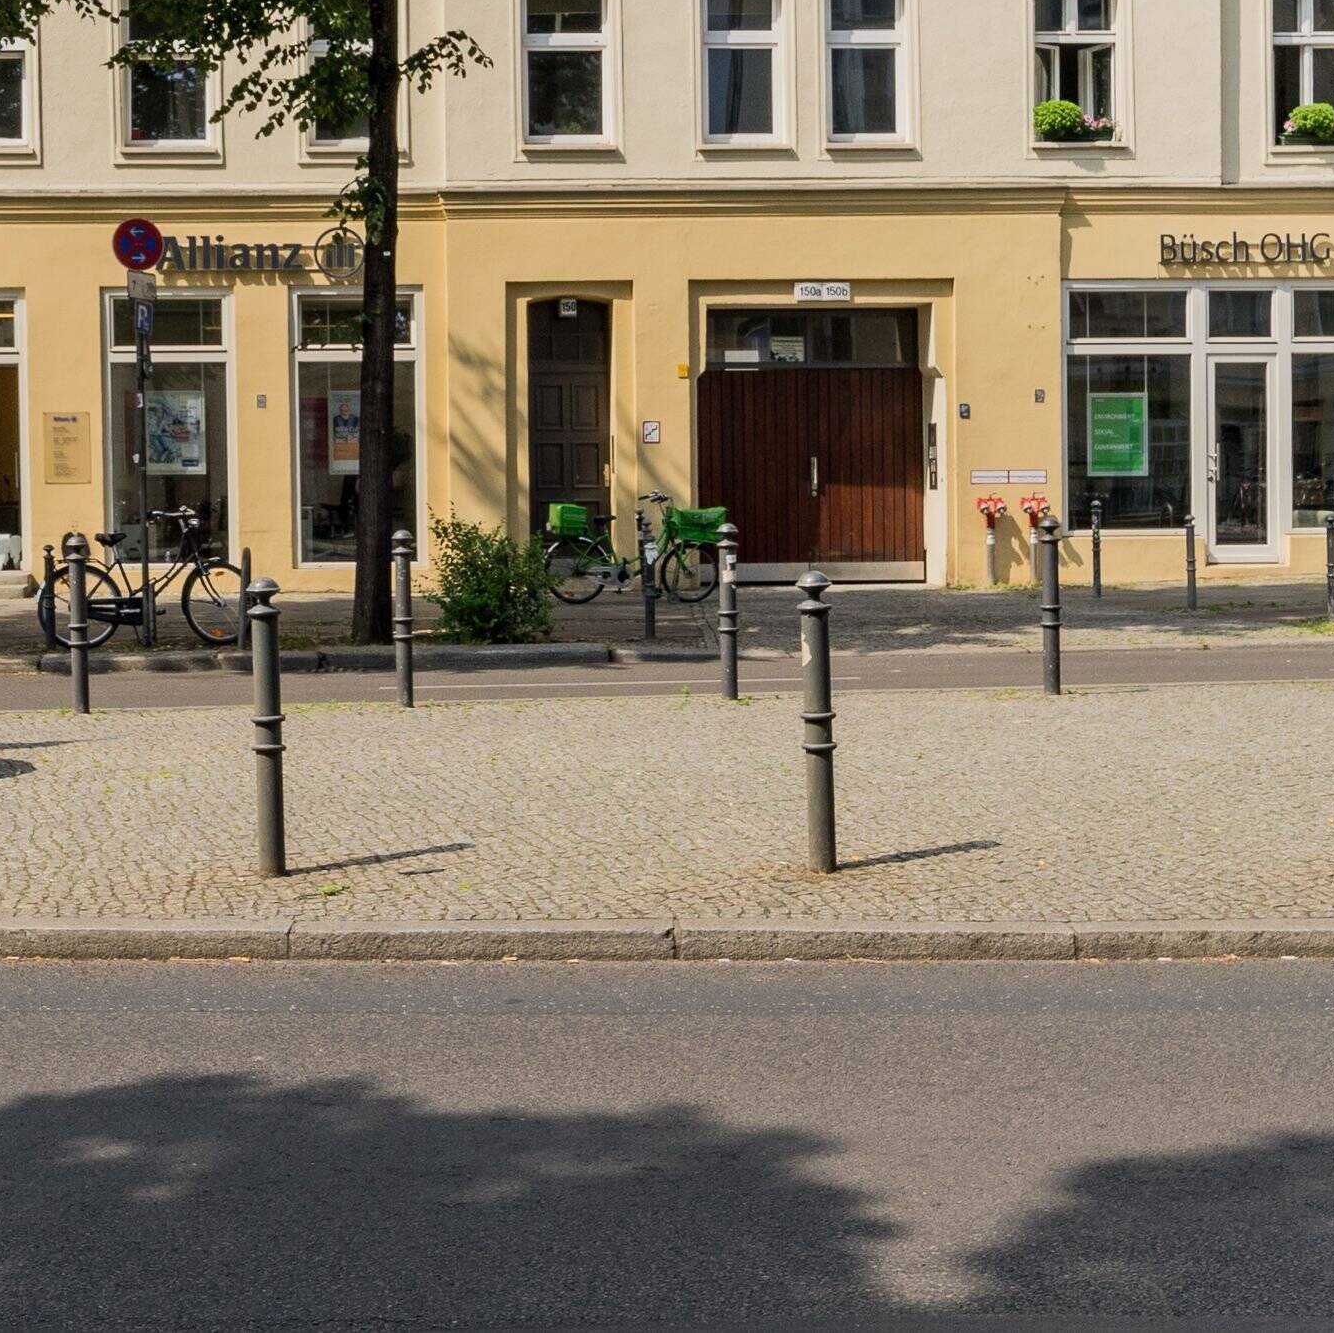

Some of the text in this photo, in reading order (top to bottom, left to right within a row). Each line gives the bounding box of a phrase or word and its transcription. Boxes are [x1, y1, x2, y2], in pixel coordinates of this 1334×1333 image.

[156, 234, 305, 271] Allianz
[1160, 231, 1331, 264] Büsch OHG
[800, 286, 849, 297] 150a 150b
[562, 300, 577, 312] 150
